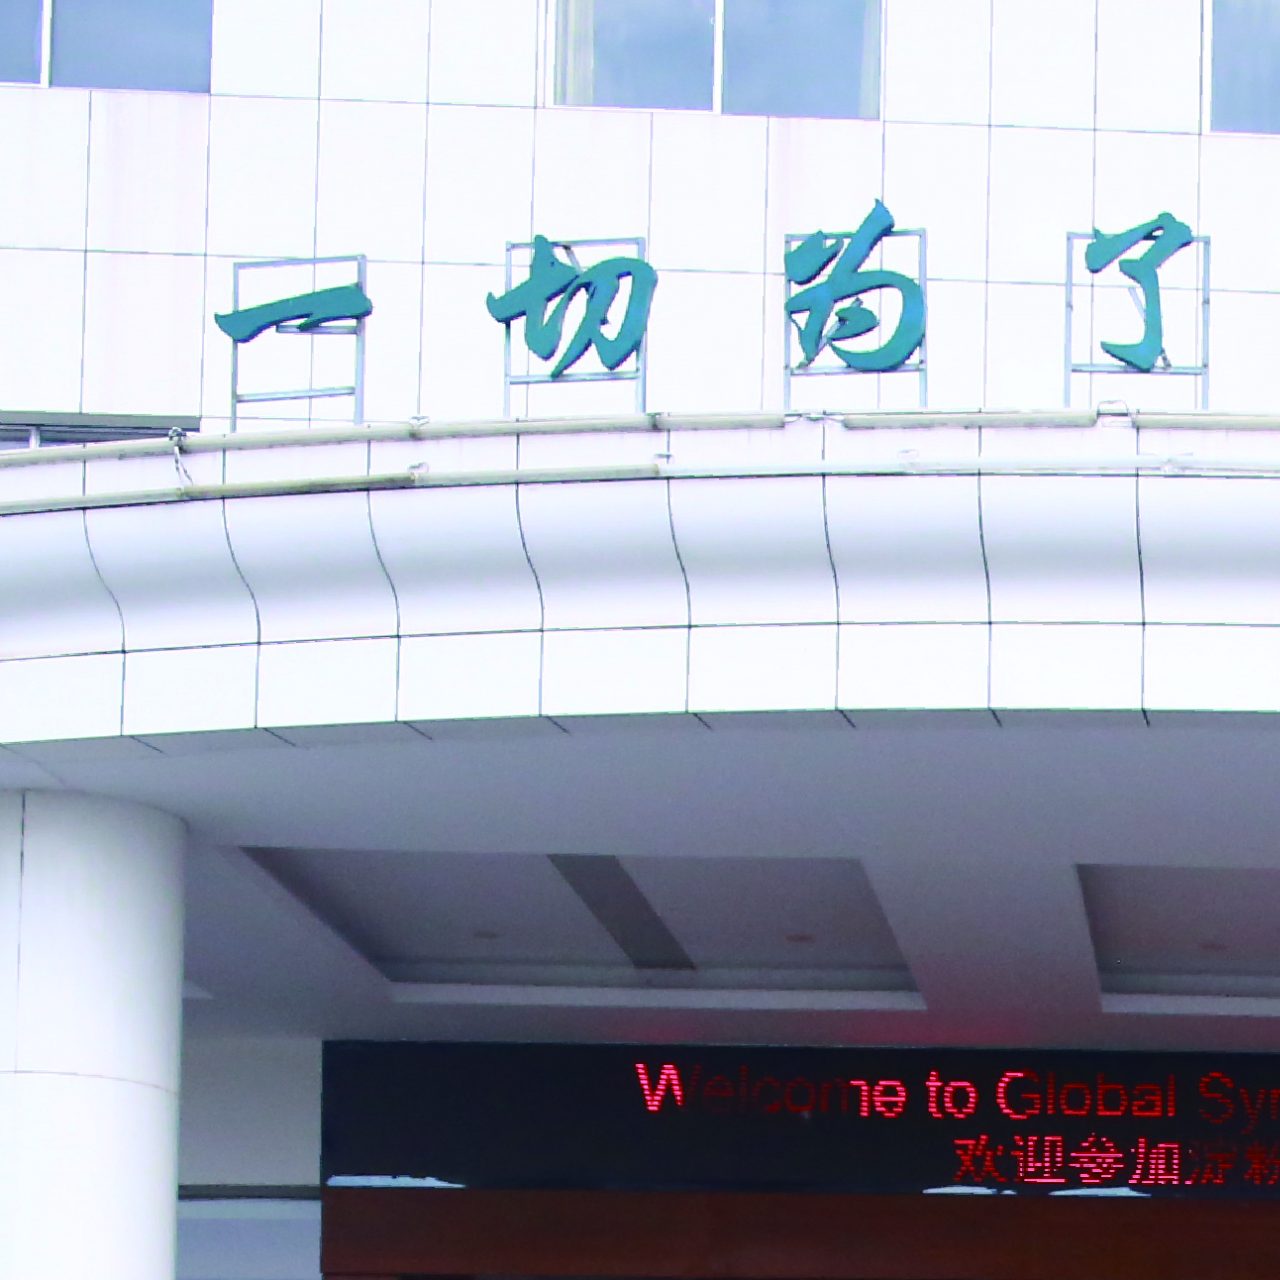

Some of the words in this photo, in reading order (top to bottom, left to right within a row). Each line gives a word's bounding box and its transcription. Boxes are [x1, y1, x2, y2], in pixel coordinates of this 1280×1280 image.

[635, 1062, 907, 1116] Welcome
[927, 1069, 979, 1120] to
[996, 1069, 1176, 1120] Global
